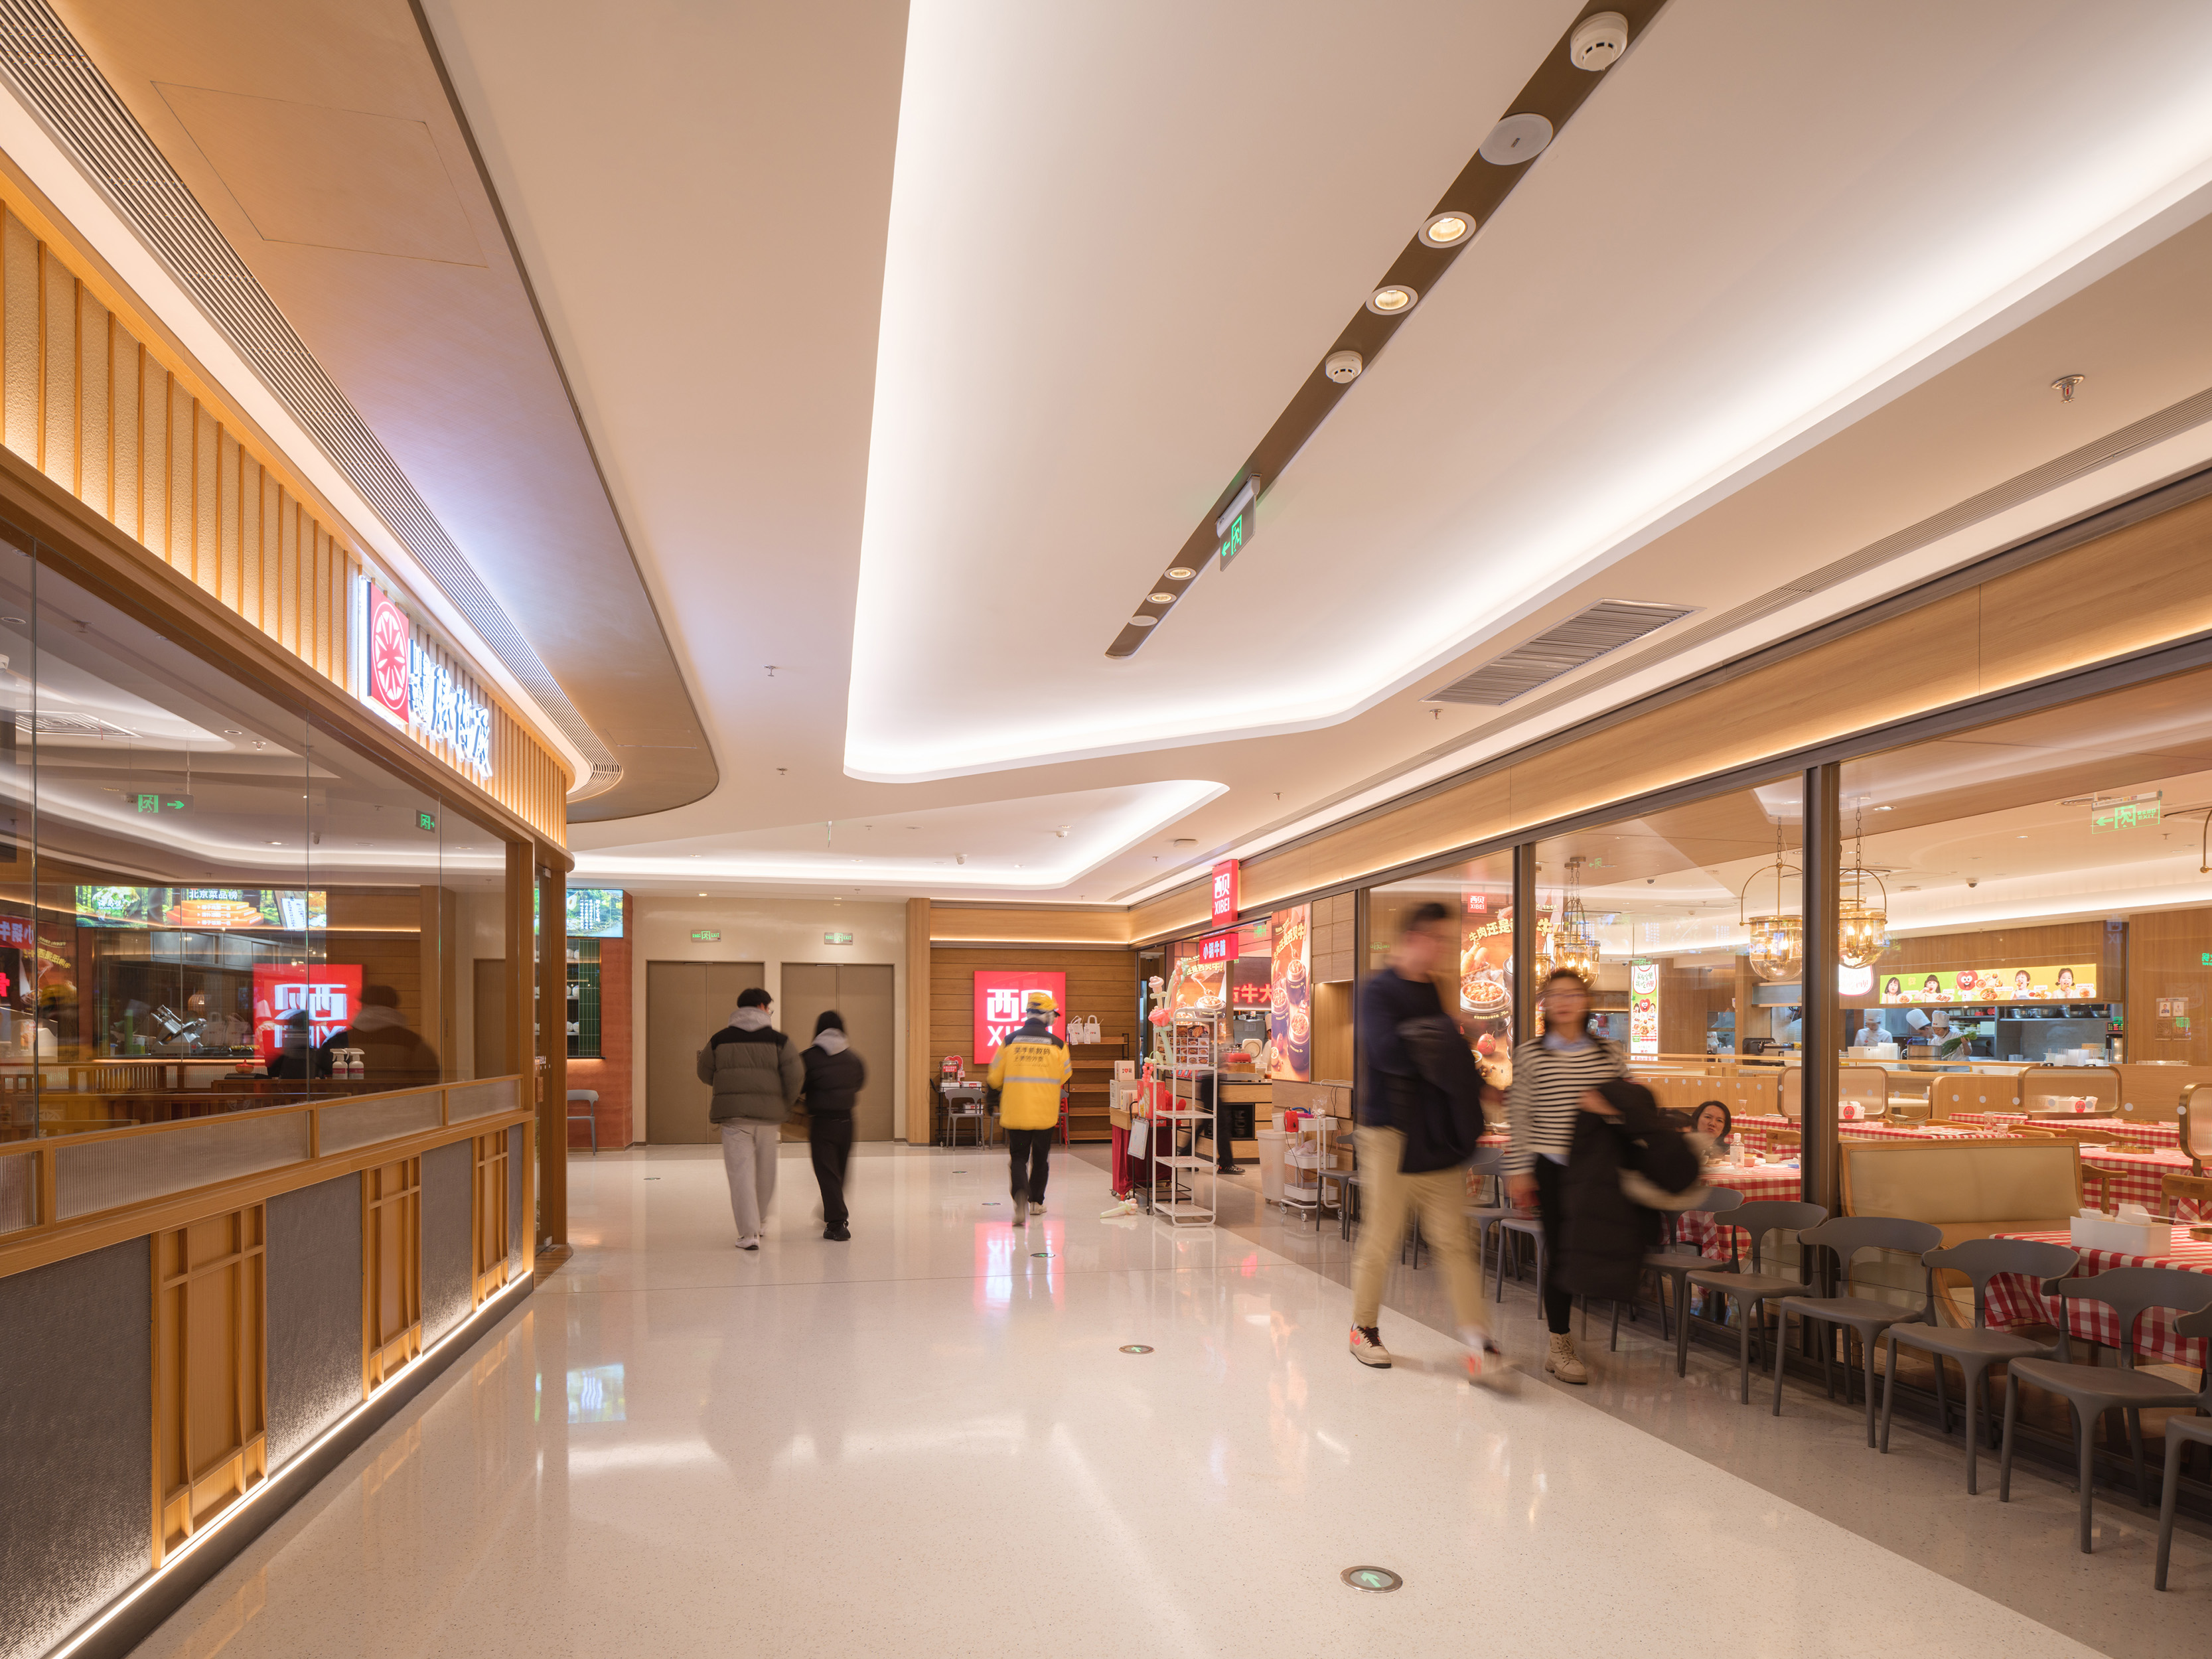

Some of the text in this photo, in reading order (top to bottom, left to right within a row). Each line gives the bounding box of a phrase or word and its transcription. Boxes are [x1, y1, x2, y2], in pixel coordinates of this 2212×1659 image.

[189, 890, 238, 900] 北京菜品榜
[1215, 873, 1230, 899] 西贝
[1215, 897, 1230, 915] XIBEI
[1470, 895, 1485, 904] 西贝
[1203, 939, 1226, 960] 小锅牛腩
